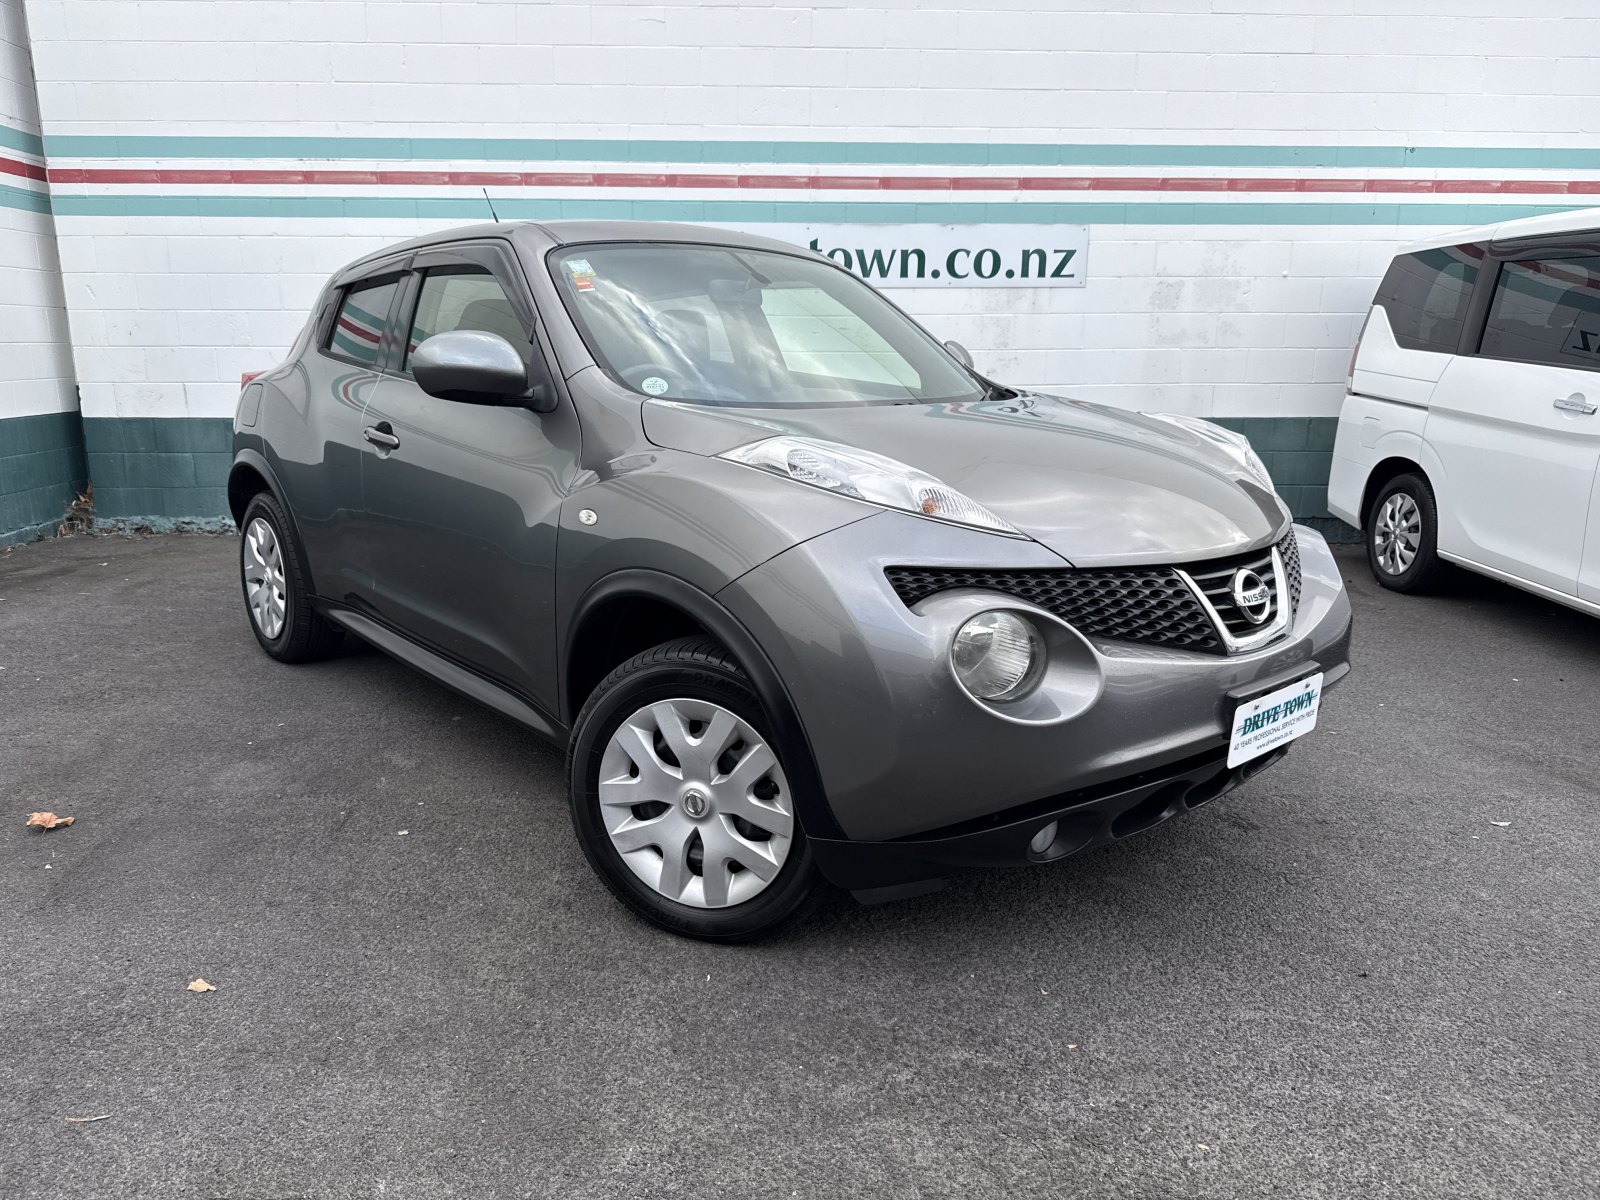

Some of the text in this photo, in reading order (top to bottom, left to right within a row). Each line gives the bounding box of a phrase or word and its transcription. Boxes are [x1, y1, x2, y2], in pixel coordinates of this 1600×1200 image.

[1241, 689, 1316, 737] DRIVE TOWN
[1240, 738, 1252, 748] YEARS
[1252, 725, 1281, 743] PROFESSIONAL
[1281, 719, 1295, 730] SERVICE
